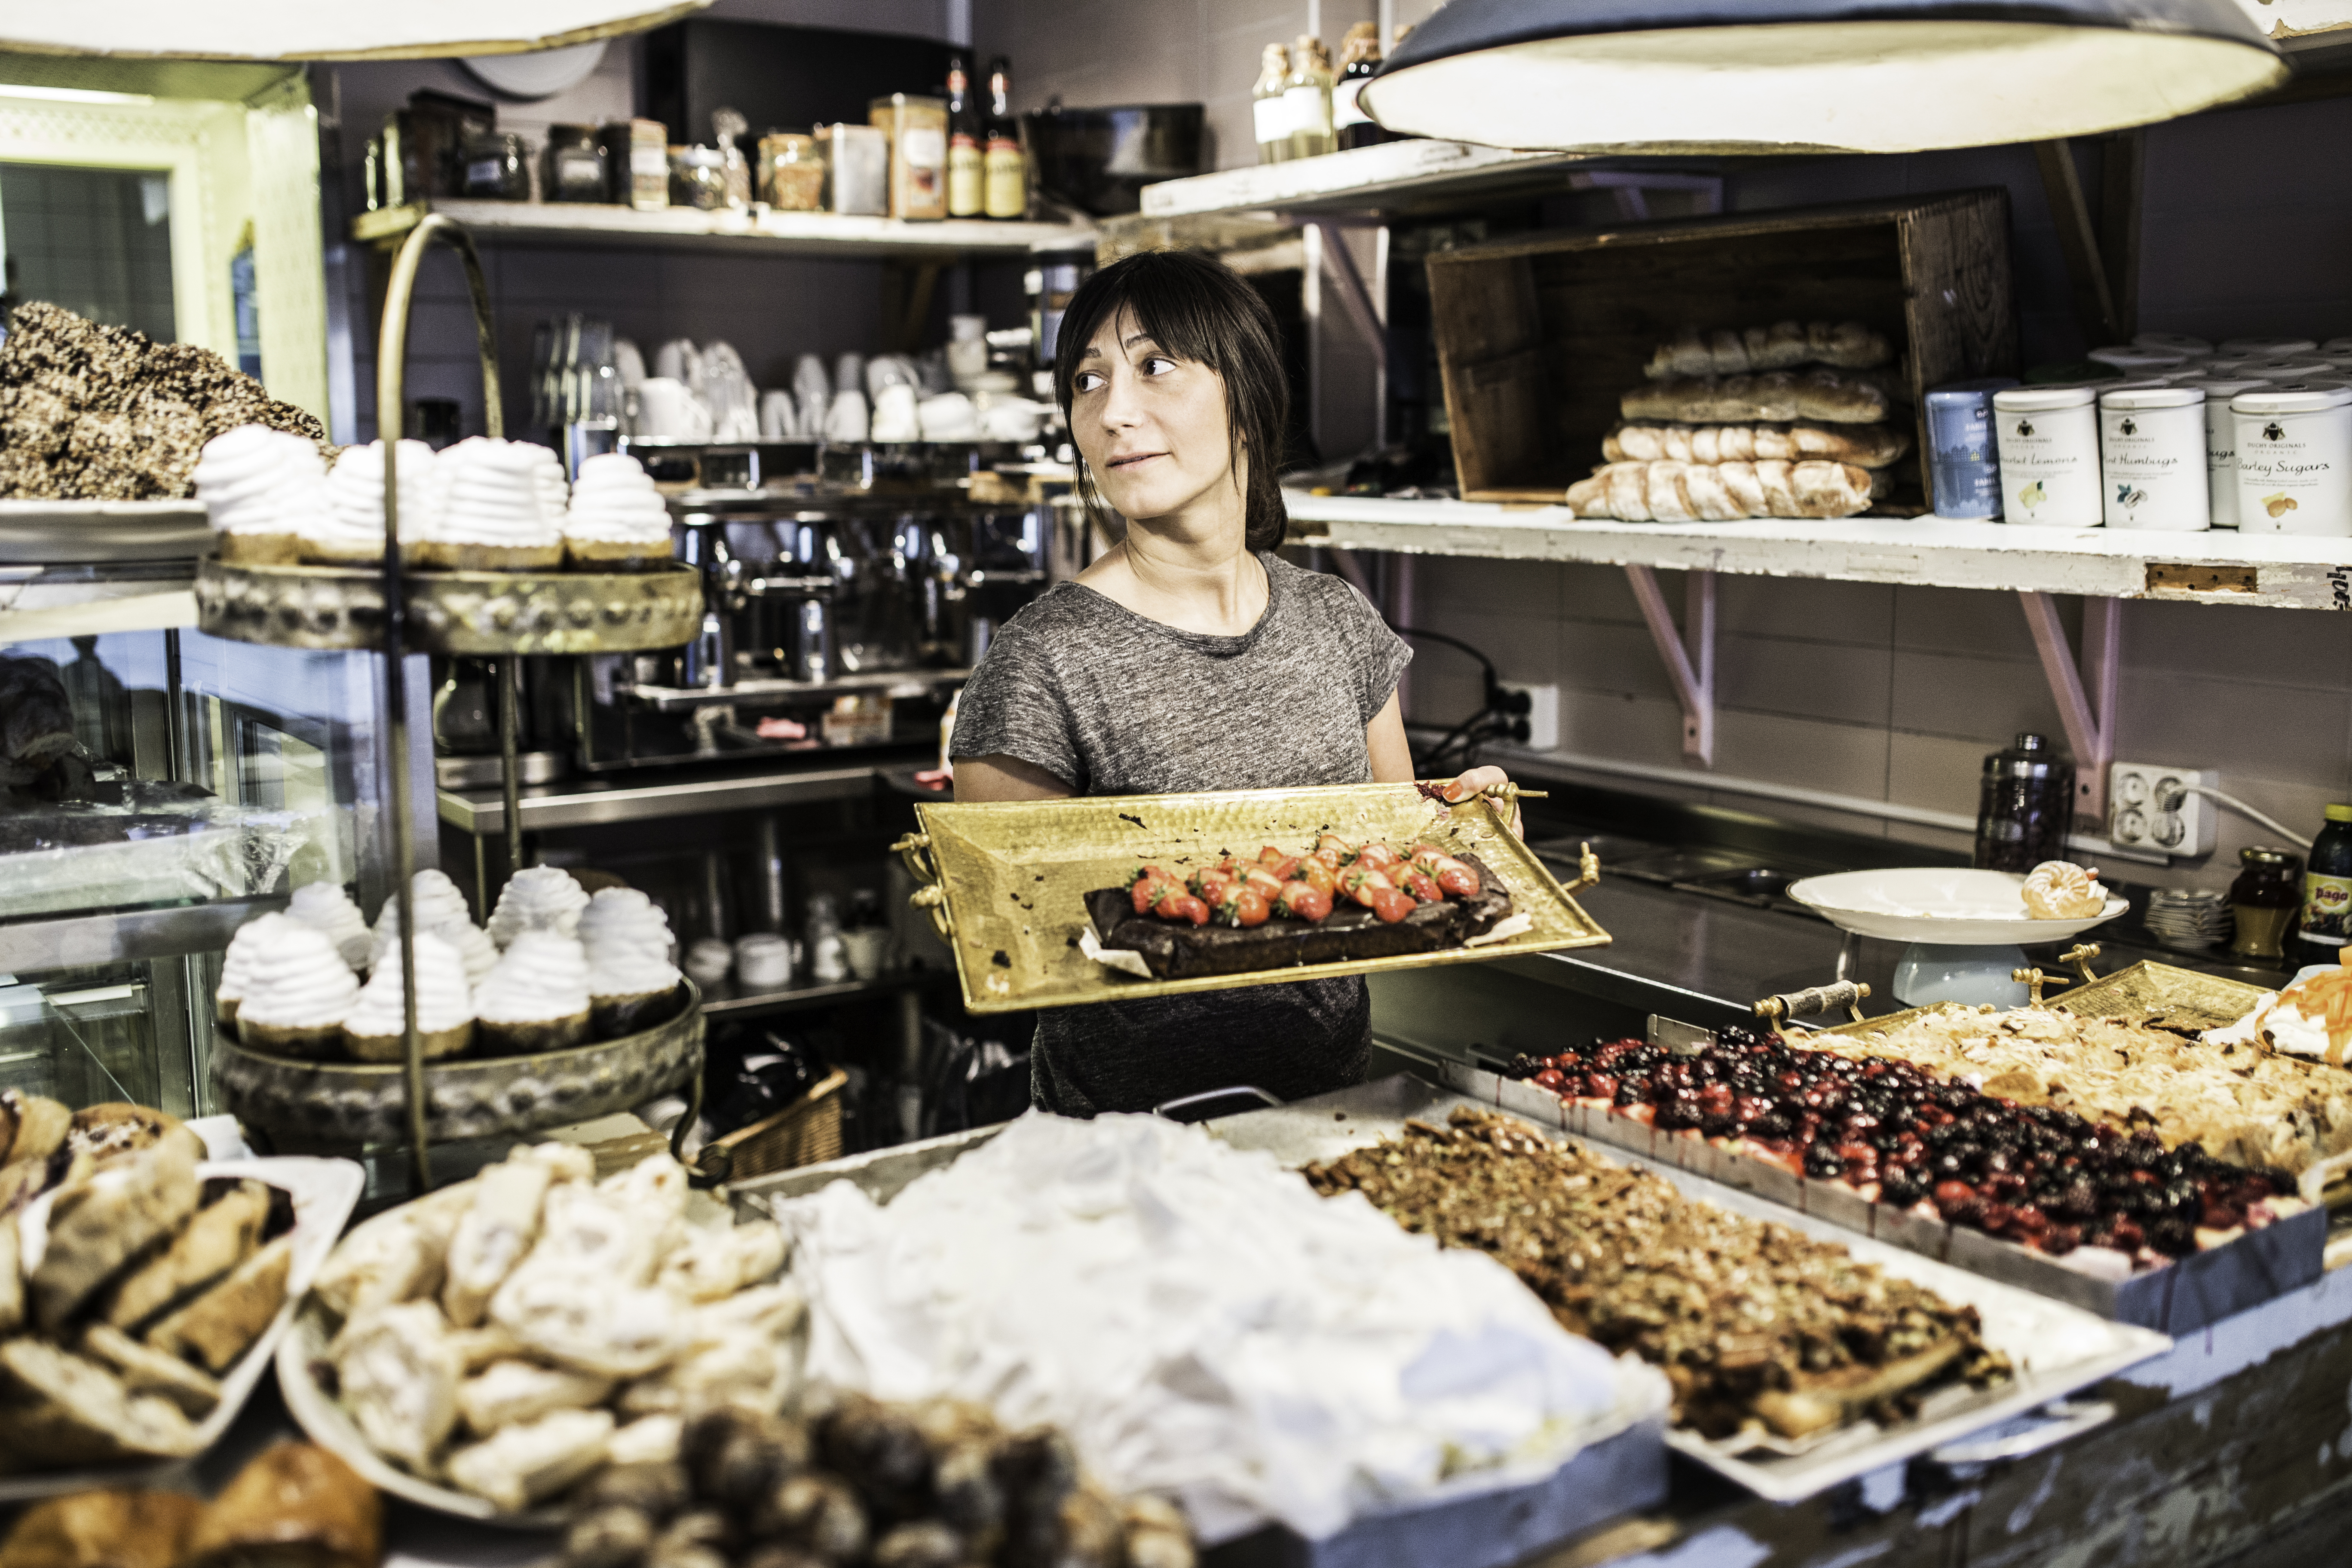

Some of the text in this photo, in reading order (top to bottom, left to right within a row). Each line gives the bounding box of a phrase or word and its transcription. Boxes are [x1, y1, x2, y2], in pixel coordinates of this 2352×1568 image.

[2120, 452, 2177, 468] Humbugs
[2237, 457, 2272, 477] Barley
[2276, 460, 2330, 475] Sugars
